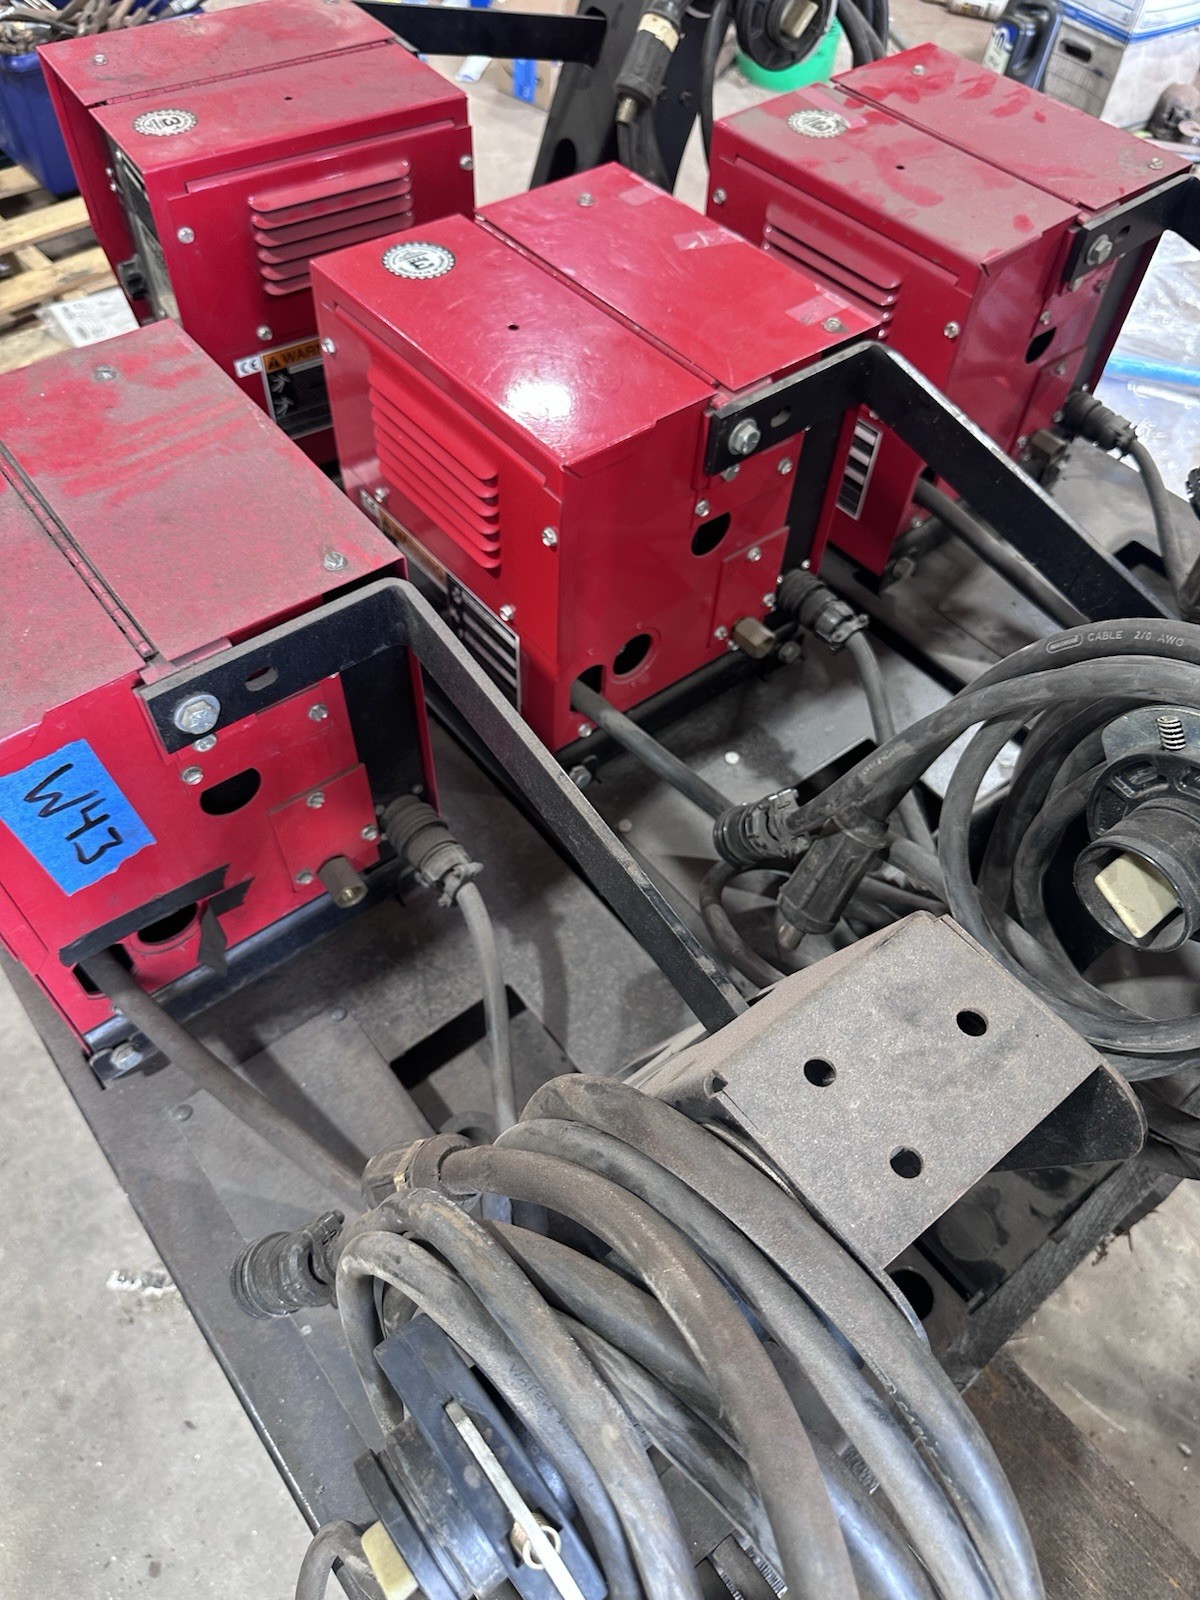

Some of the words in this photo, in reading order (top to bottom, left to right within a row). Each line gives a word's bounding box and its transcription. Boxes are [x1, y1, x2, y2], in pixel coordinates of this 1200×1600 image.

[1086, 630, 1123, 643] CABLE
[1133, 630, 1152, 641] 2/0
[1156, 633, 1185, 648] AWG
[23, 762, 124, 865] W43
